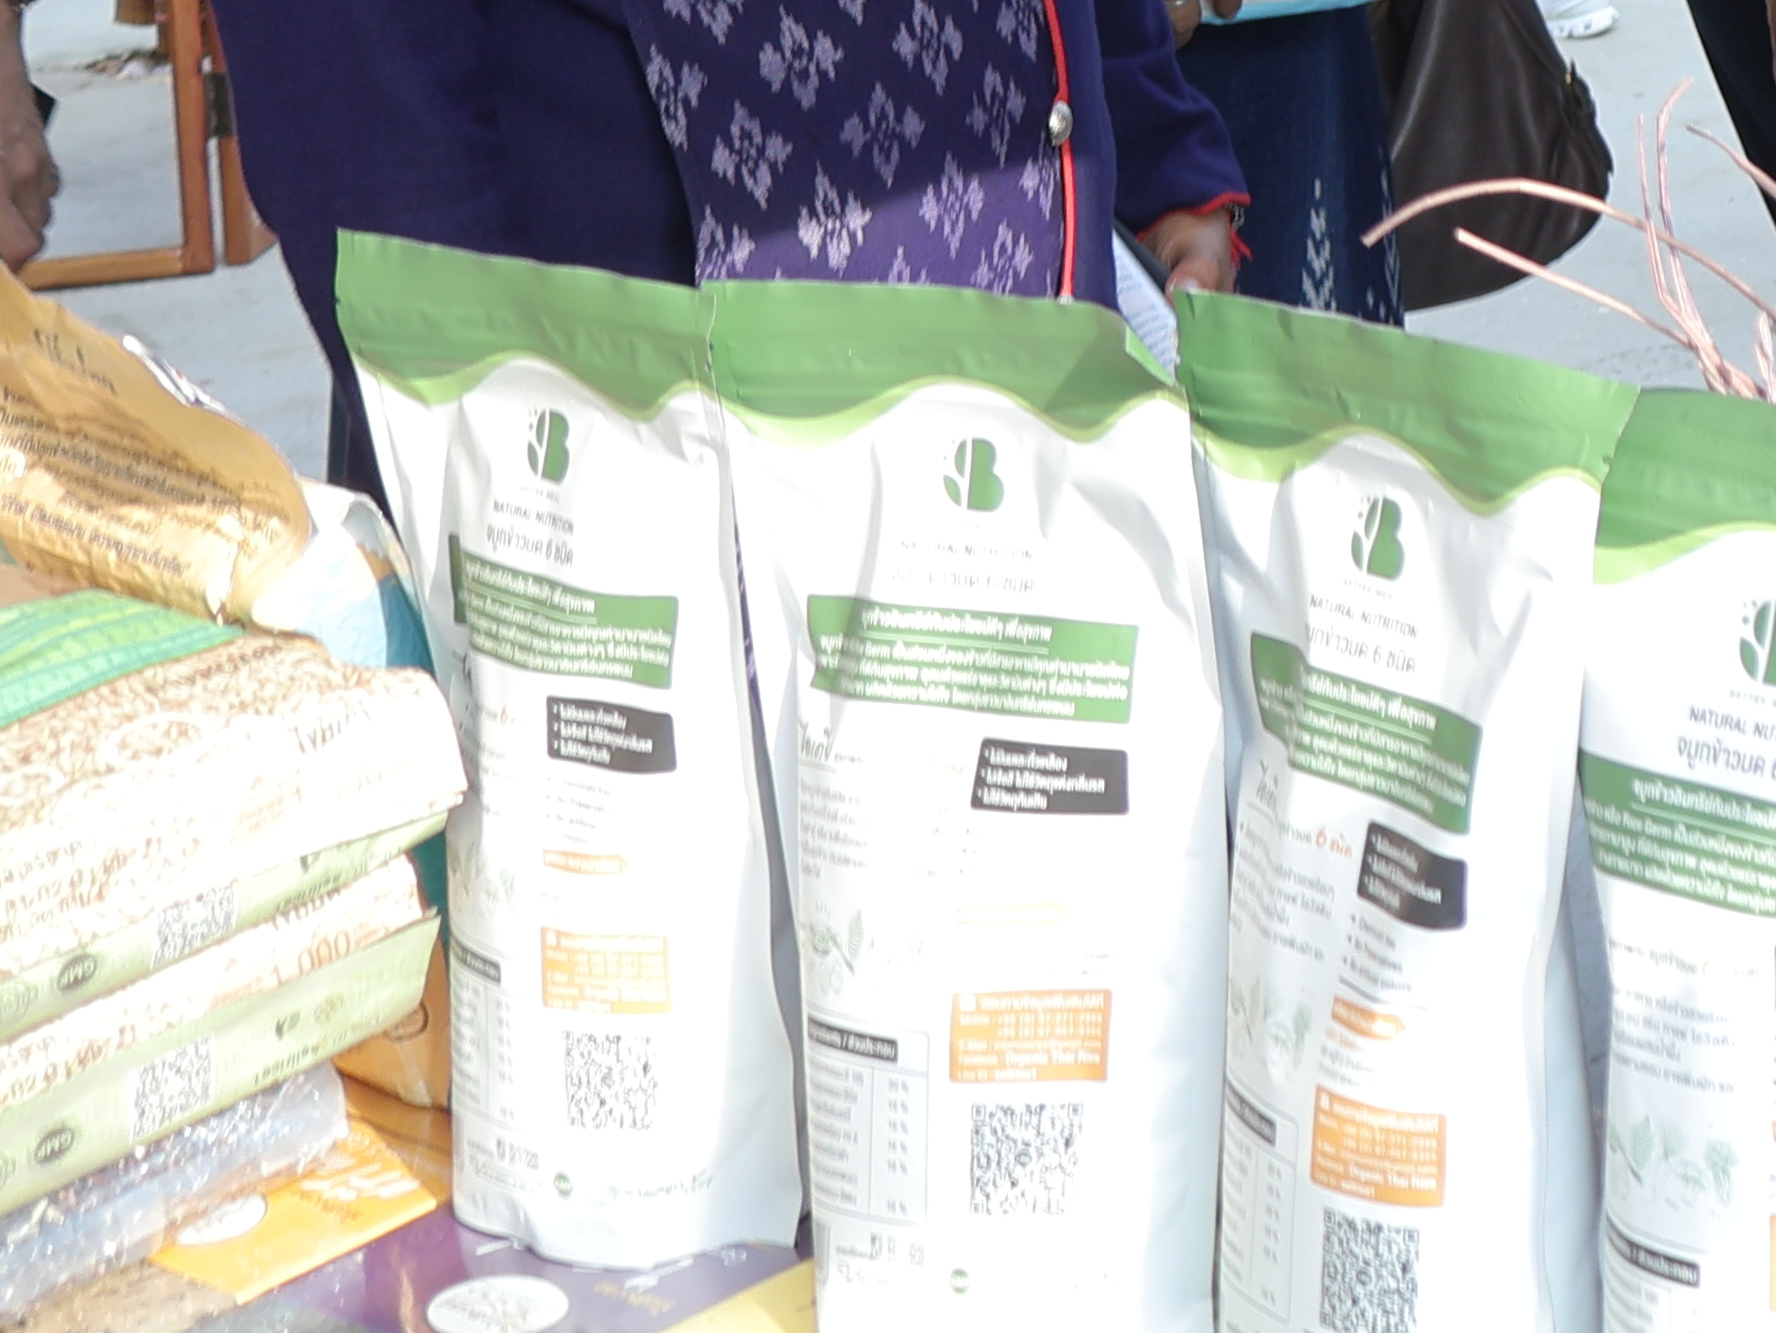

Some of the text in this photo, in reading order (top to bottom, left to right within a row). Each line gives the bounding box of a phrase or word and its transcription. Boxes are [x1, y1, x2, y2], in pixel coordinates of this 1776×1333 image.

[1359, 608, 1418, 640] NUTRITION
[1688, 704, 1748, 736] NATURAL
[1676, 734, 1766, 778] จมูกข้าวบด
[61, 956, 96, 986] GMP
[36, 1129, 73, 1159] GMP
